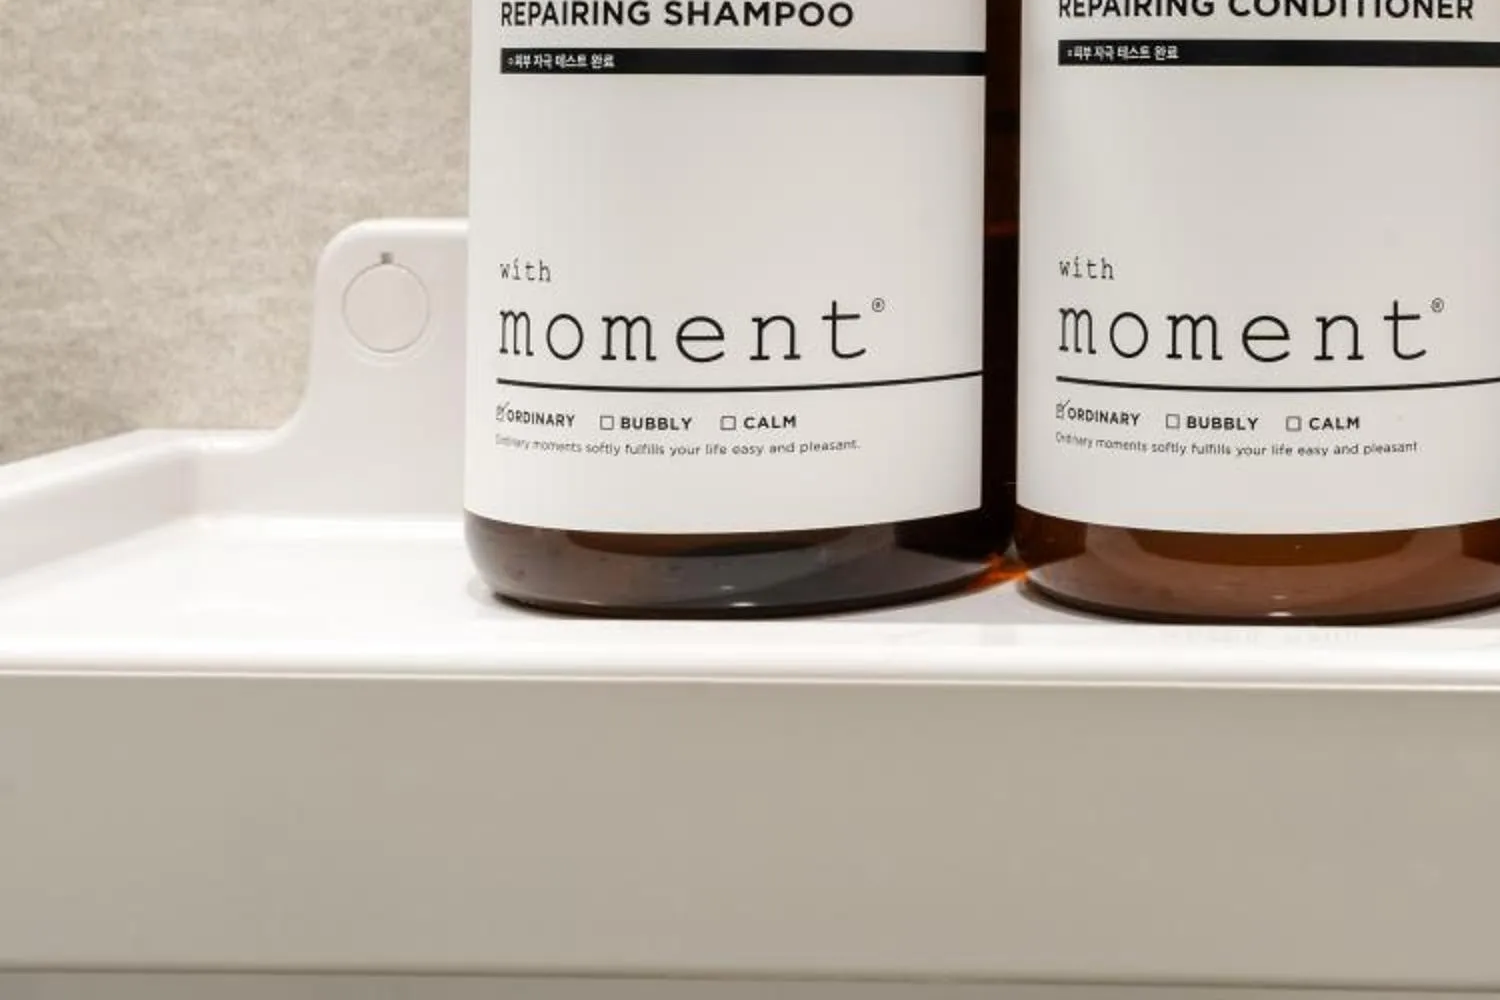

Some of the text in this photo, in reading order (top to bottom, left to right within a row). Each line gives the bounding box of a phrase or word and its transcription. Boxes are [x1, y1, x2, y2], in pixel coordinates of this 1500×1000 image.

[664, 0, 855, 29] SHAMPOO
[507, 409, 797, 431] ORDINARY BUBBLY CALM
[1067, 407, 1361, 431] ORDINARY BUBBLY CALM
[585, 442, 620, 456] softly
[625, 443, 665, 455] fulfills
[669, 446, 701, 457] your
[705, 443, 727, 456] life
[732, 446, 764, 457] easy
[769, 442, 796, 454] and
[1151, 441, 1188, 456] softly
[1235, 447, 1268, 458] your
[1271, 443, 1293, 455] life
[1297, 447, 1329, 457] easy
[1333, 443, 1360, 455] and
